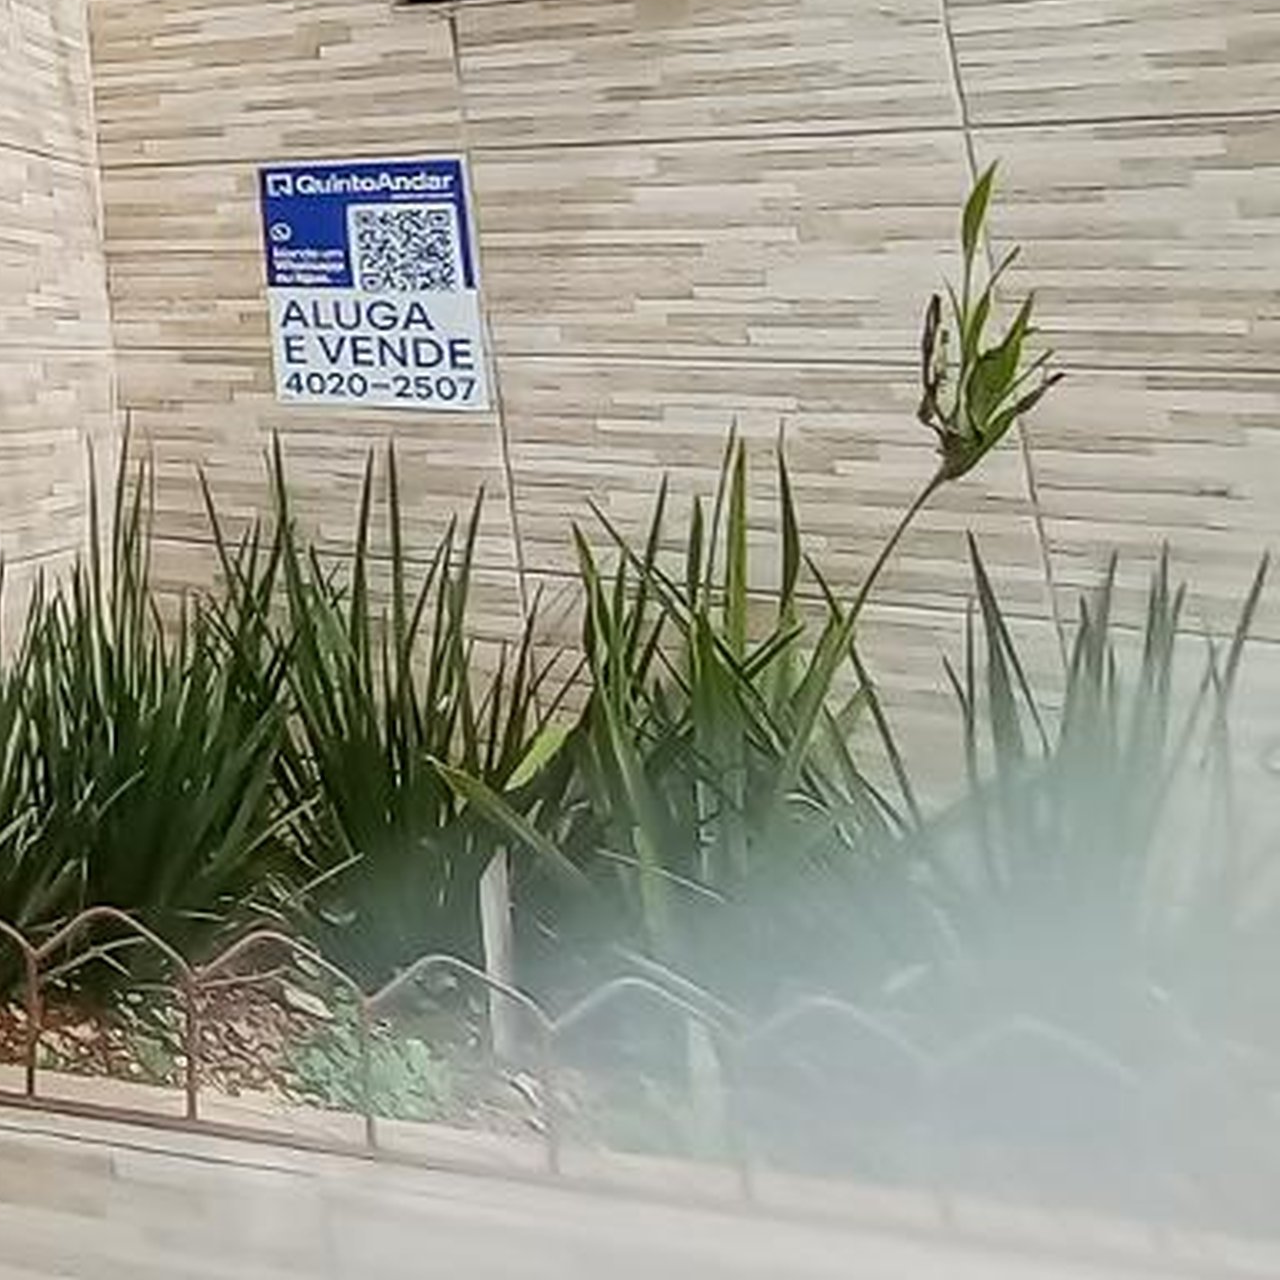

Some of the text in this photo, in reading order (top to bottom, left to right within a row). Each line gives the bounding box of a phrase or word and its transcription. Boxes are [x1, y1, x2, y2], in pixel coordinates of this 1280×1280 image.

[296, 172, 454, 195] QuintoAndar
[281, 300, 435, 331] ALUGA
[284, 335, 475, 370] E VENDE
[285, 372, 477, 401] 4020-2507
